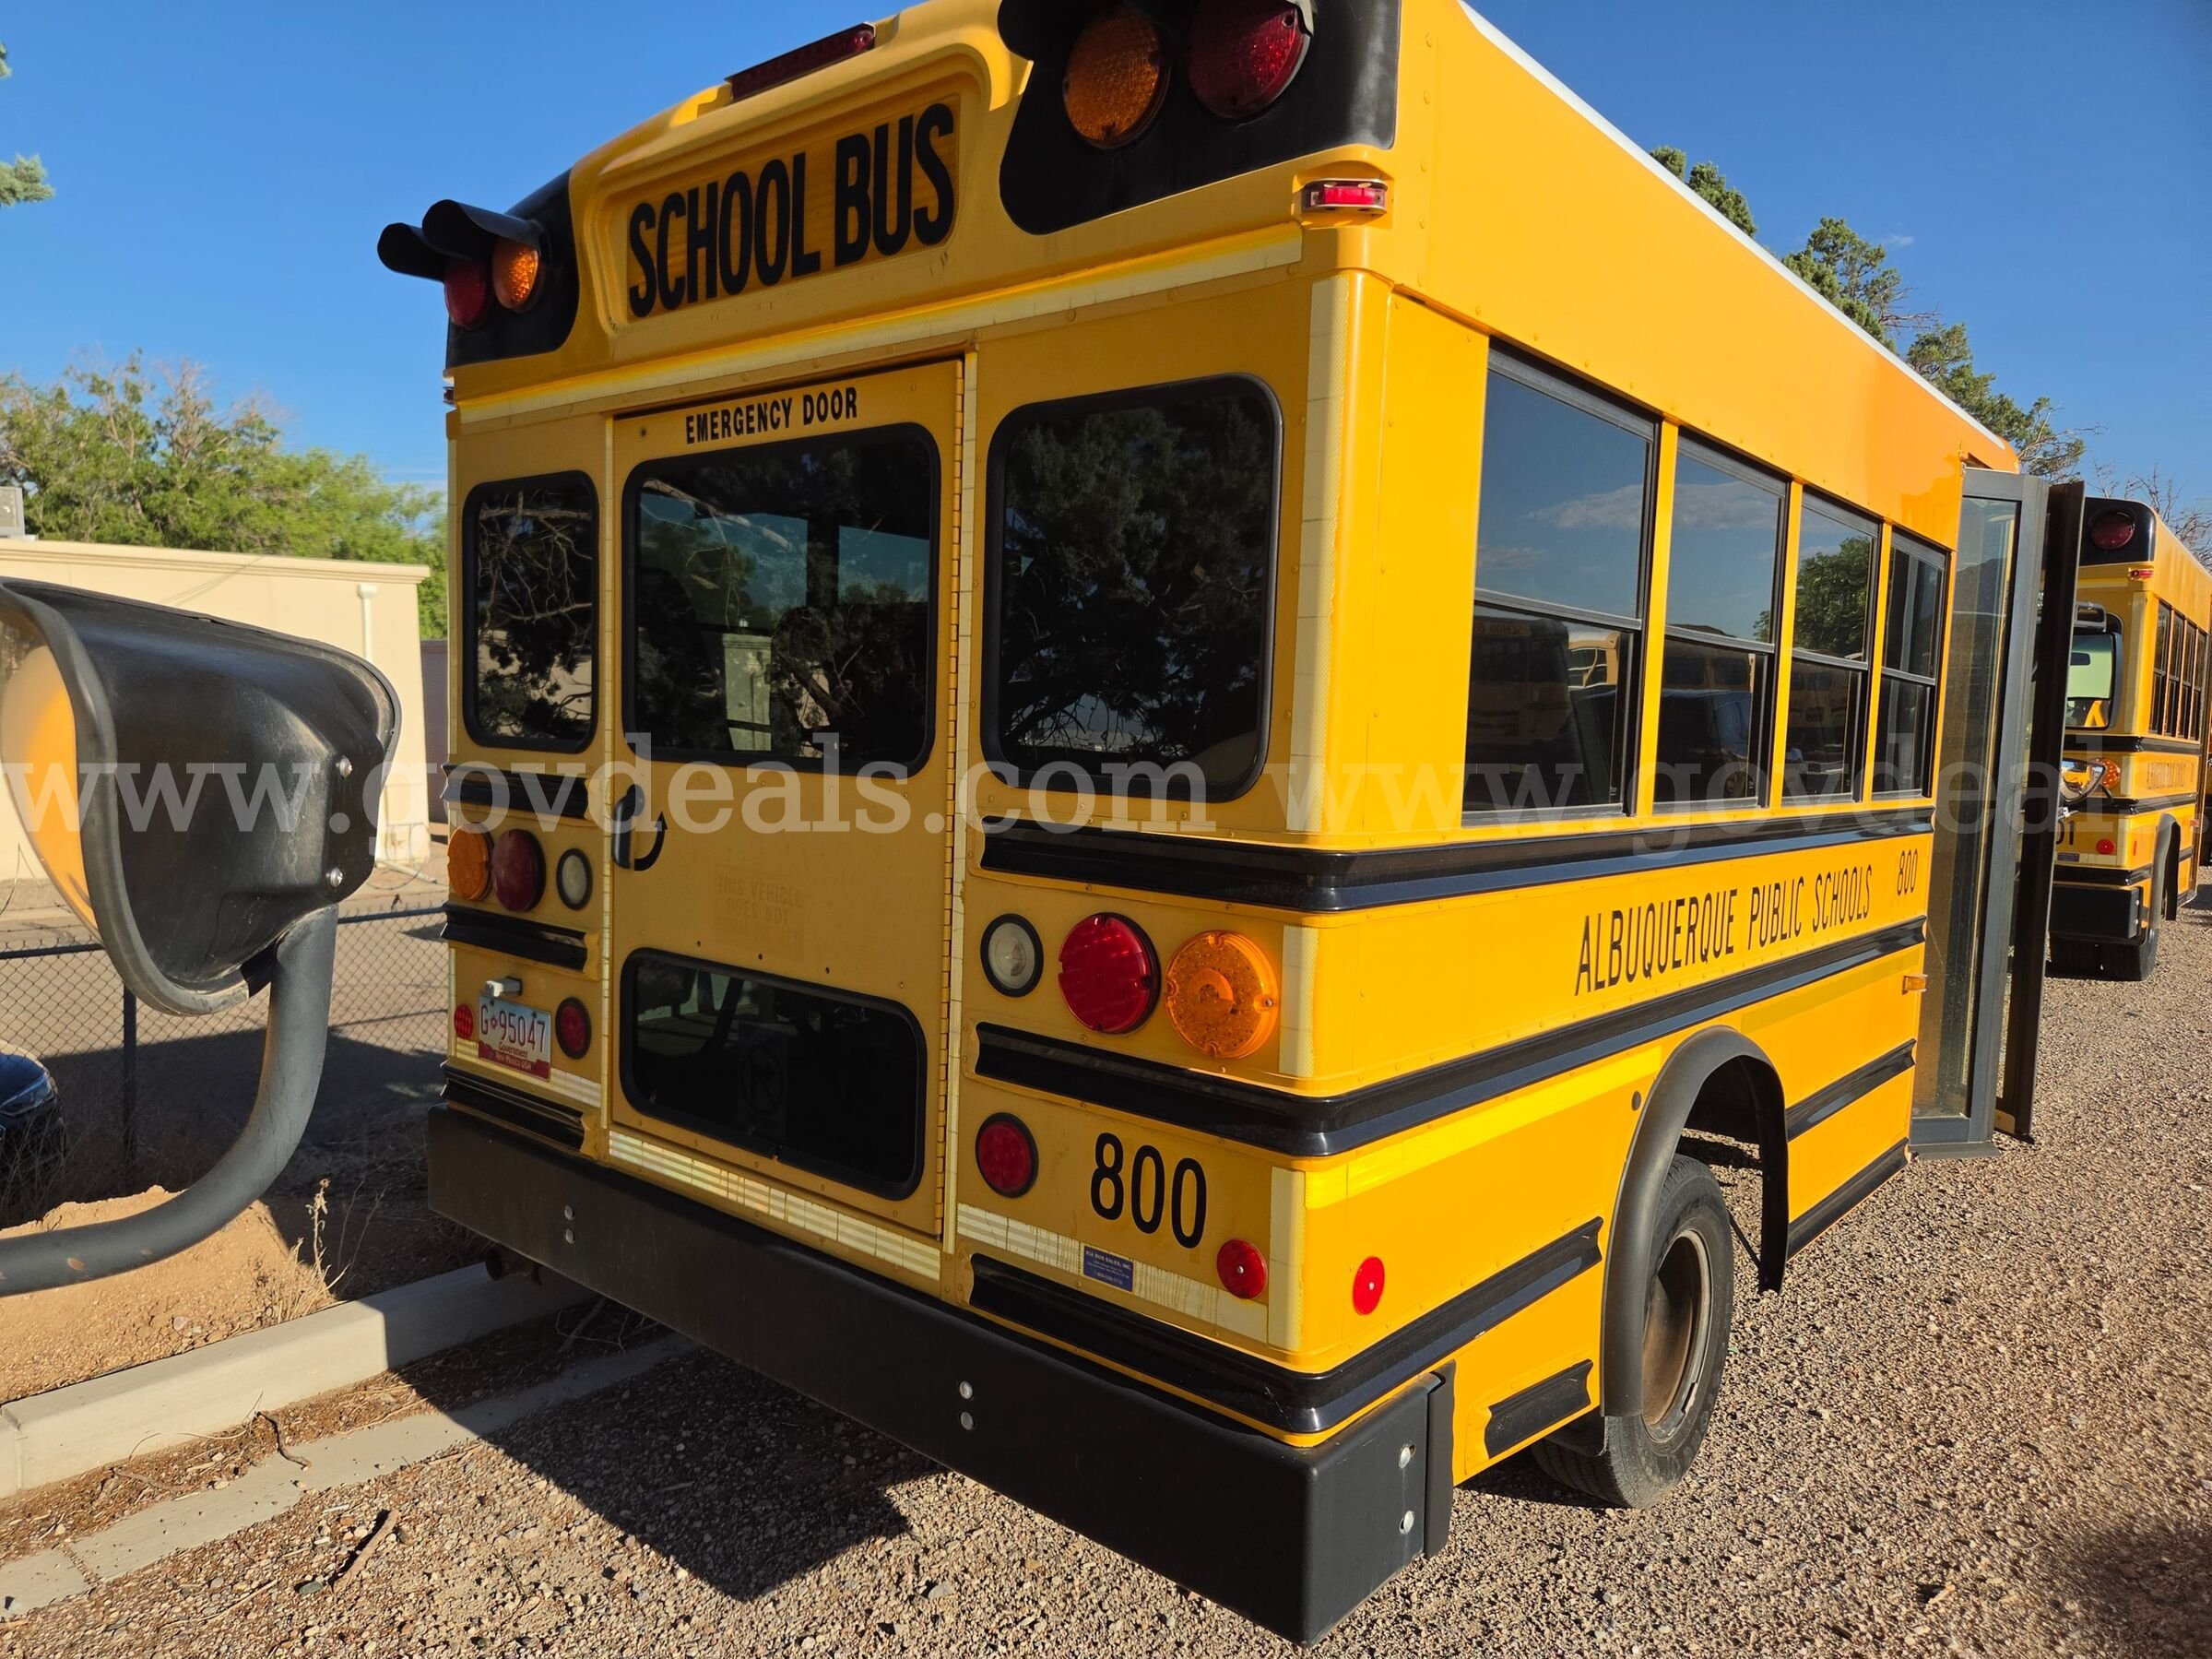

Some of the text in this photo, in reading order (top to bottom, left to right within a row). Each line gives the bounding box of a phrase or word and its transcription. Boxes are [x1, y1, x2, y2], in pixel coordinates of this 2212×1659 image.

[629, 103, 954, 317] SCHOOL BUS
[685, 387, 858, 444] EMERGENCY DOOR
[1574, 864, 1873, 997] ALBUQUERQUE PUBLIC SCHOOLS
[1896, 848, 1919, 896] 800
[1090, 1132, 1207, 1250] 800
